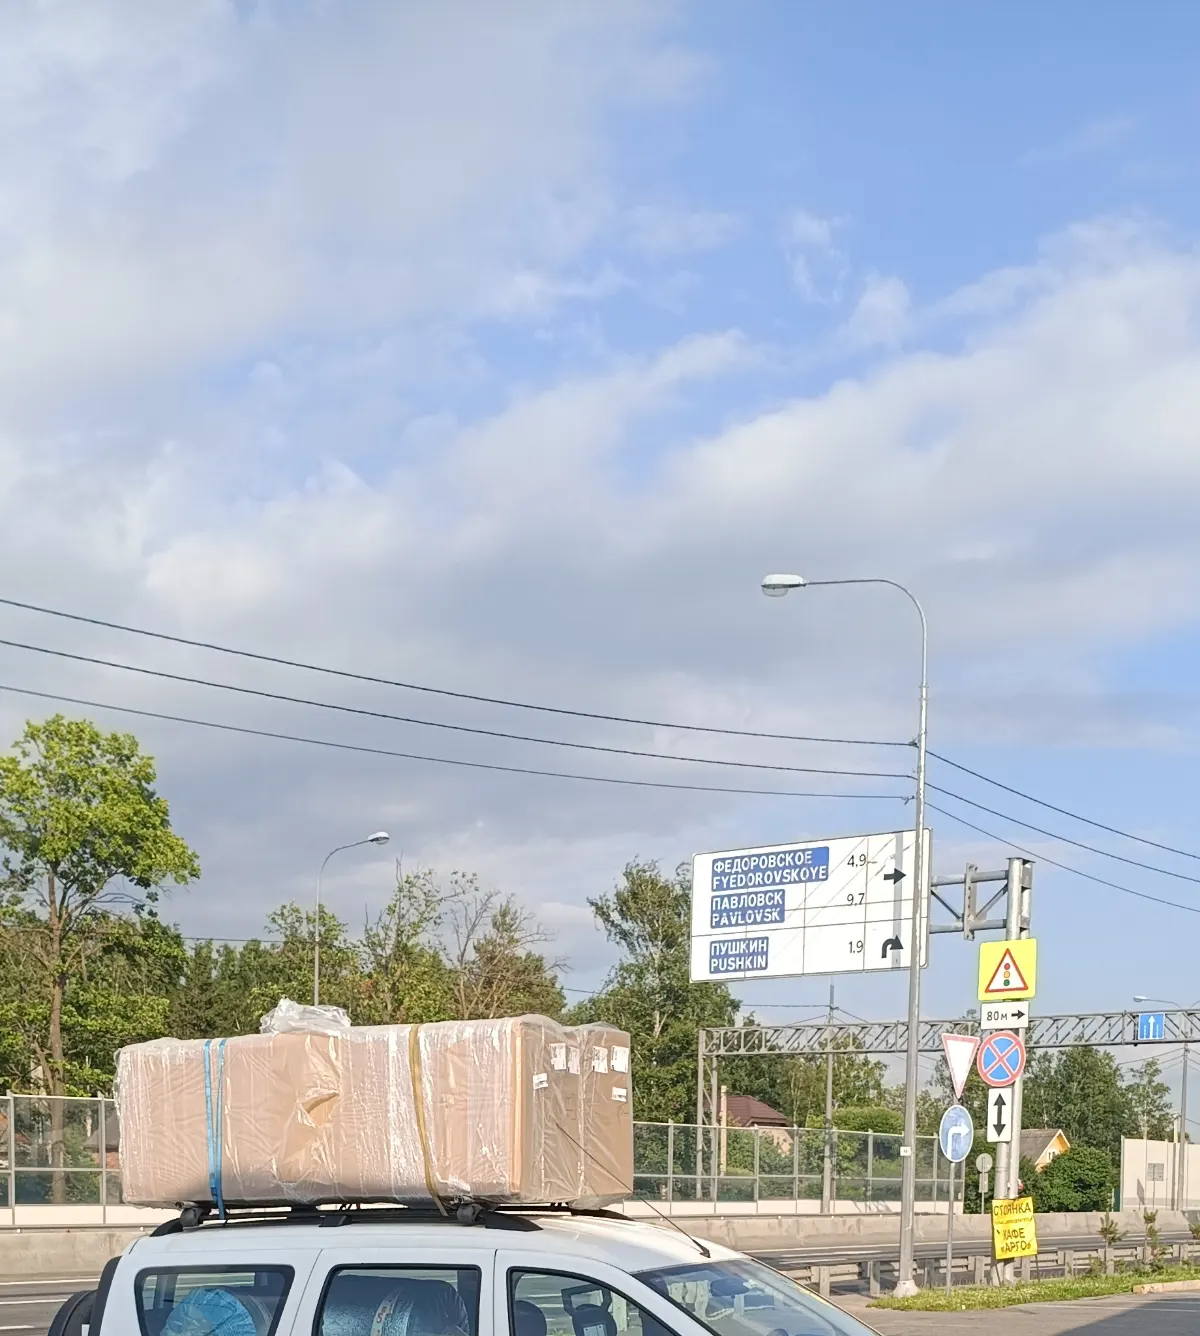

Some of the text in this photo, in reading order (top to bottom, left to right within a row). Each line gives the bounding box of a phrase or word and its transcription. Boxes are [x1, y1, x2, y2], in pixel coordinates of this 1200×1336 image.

[713, 851, 812, 874] ФЕДОРОВСКОЕ
[847, 854, 866, 868] 4.9
[712, 865, 827, 890] FYEDOROVSKOYE
[712, 891, 783, 910] ПАВЛОВСК
[846, 893, 865, 906] 9.7
[712, 907, 781, 927] PAVLOVSK
[711, 939, 767, 956] ПУШКИН
[849, 940, 864, 954] 1.9
[710, 955, 767, 972] PUSHKIN
[994, 1203, 1031, 1216] СТОЯНКА
[1003, 1228, 1025, 1240] КАФЕ
